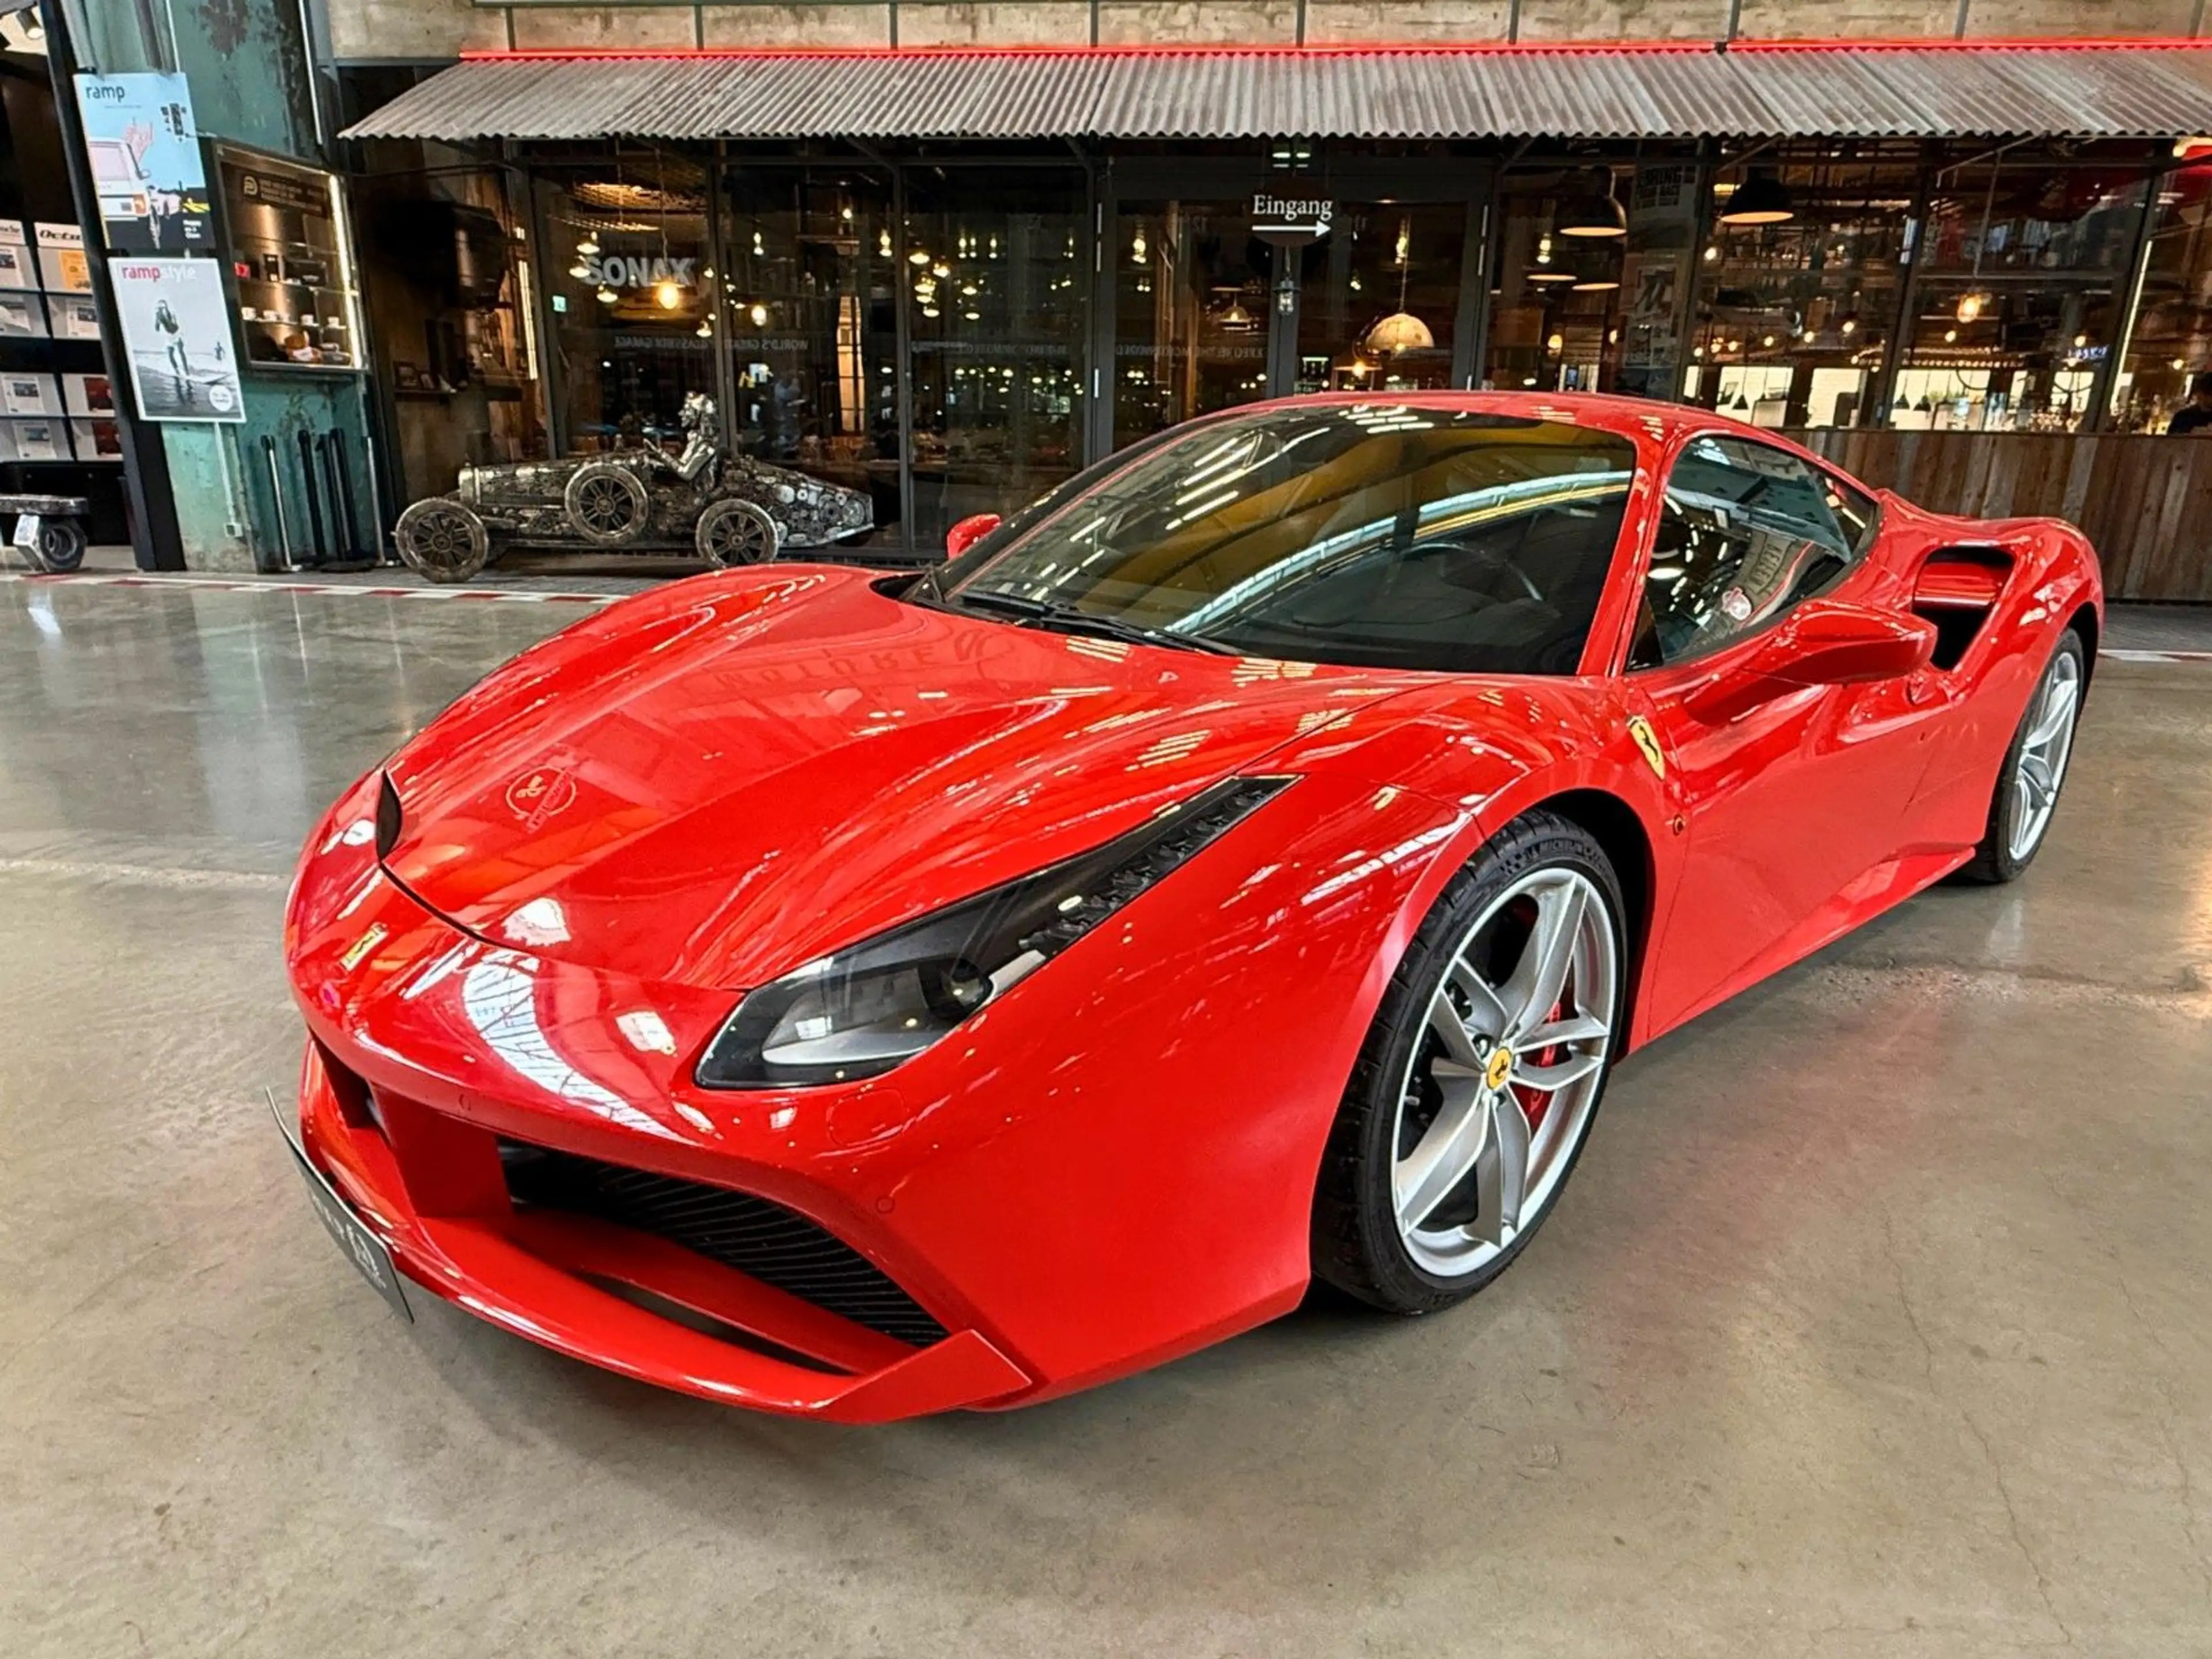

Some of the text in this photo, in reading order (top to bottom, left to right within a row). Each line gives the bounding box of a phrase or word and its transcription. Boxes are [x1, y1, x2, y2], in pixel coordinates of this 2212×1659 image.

[86, 86, 125, 103] ramp
[1252, 195, 1334, 221] Eingang
[579, 256, 695, 287] SONAX
